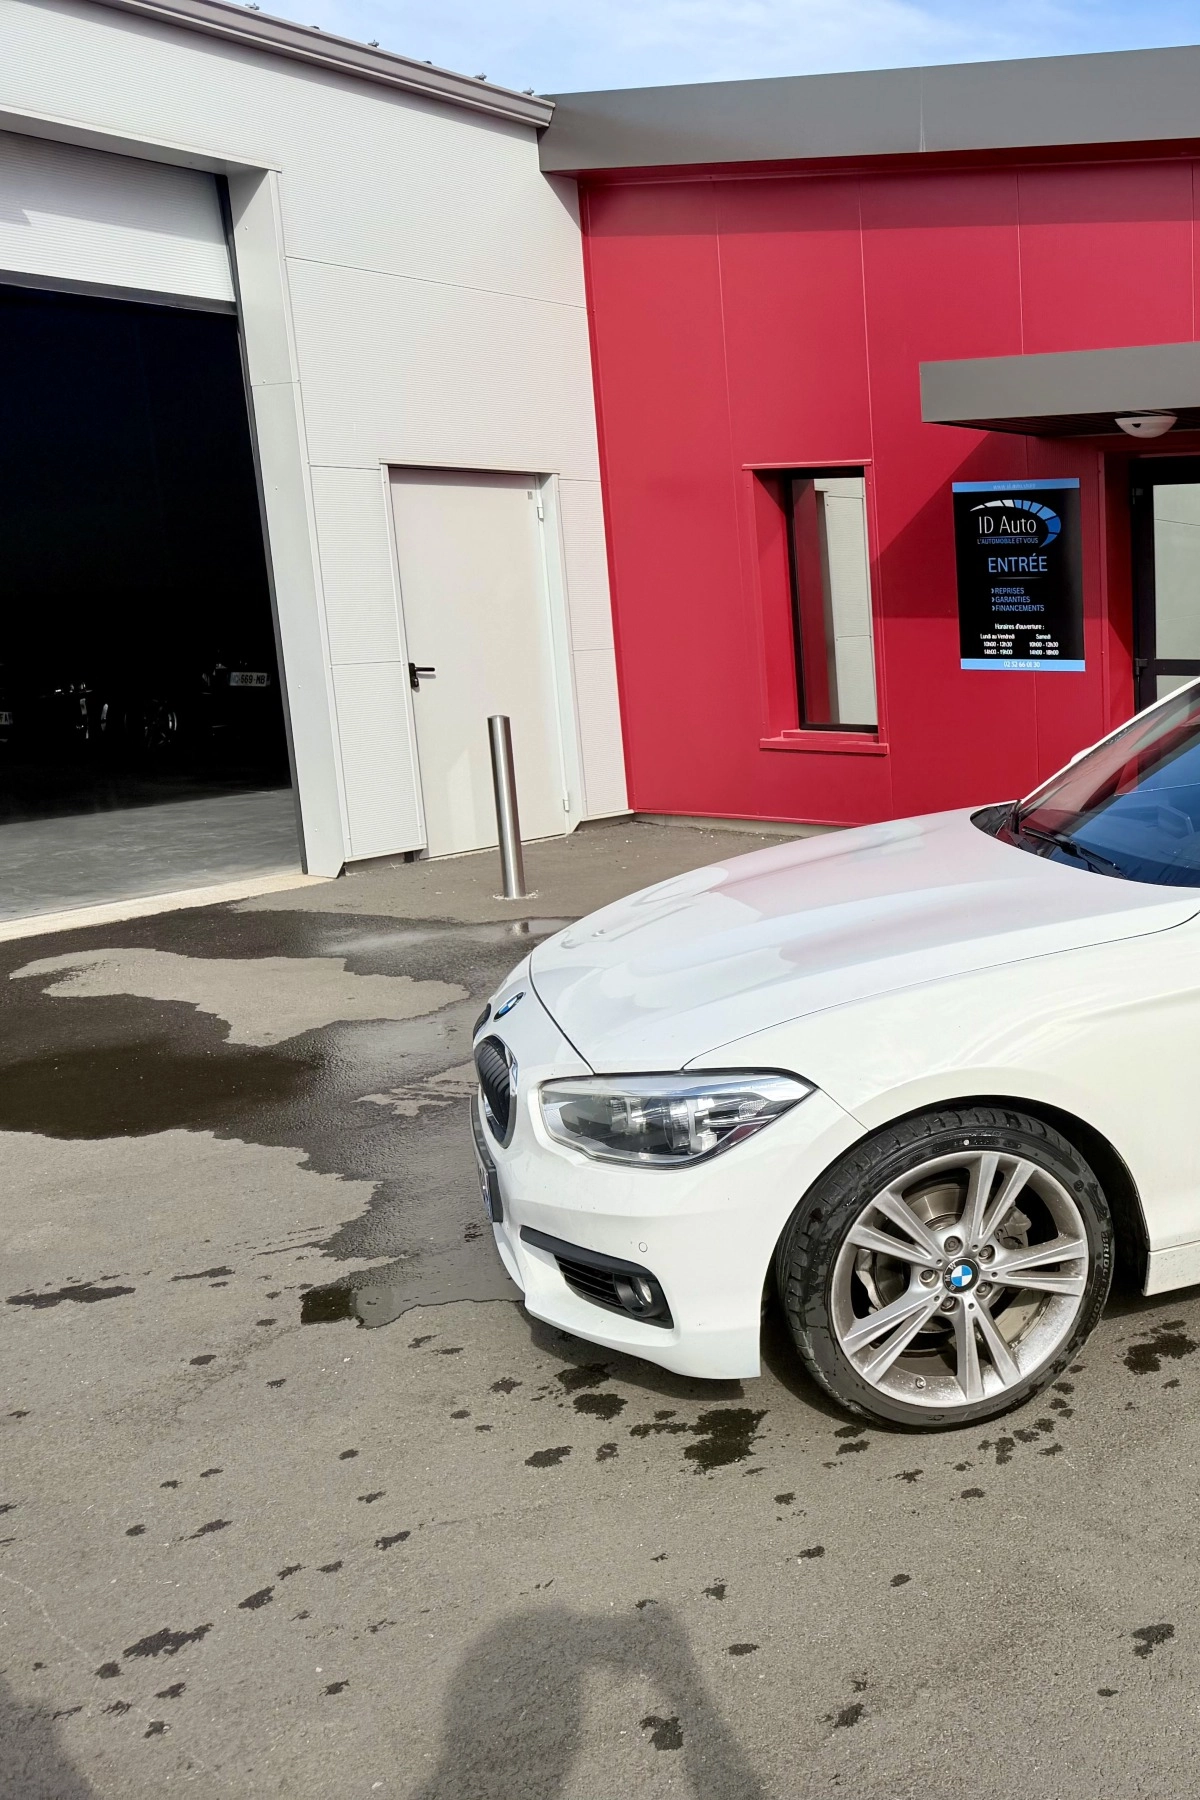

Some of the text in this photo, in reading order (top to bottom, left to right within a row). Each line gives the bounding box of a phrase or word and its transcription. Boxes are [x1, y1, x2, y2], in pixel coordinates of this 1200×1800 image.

[978, 515, 1037, 534] ID Auto
[988, 552, 1048, 573] ENTRÉE
[994, 587, 1025, 595] REPRISES
[995, 604, 1045, 612] FINANCEMENTS
